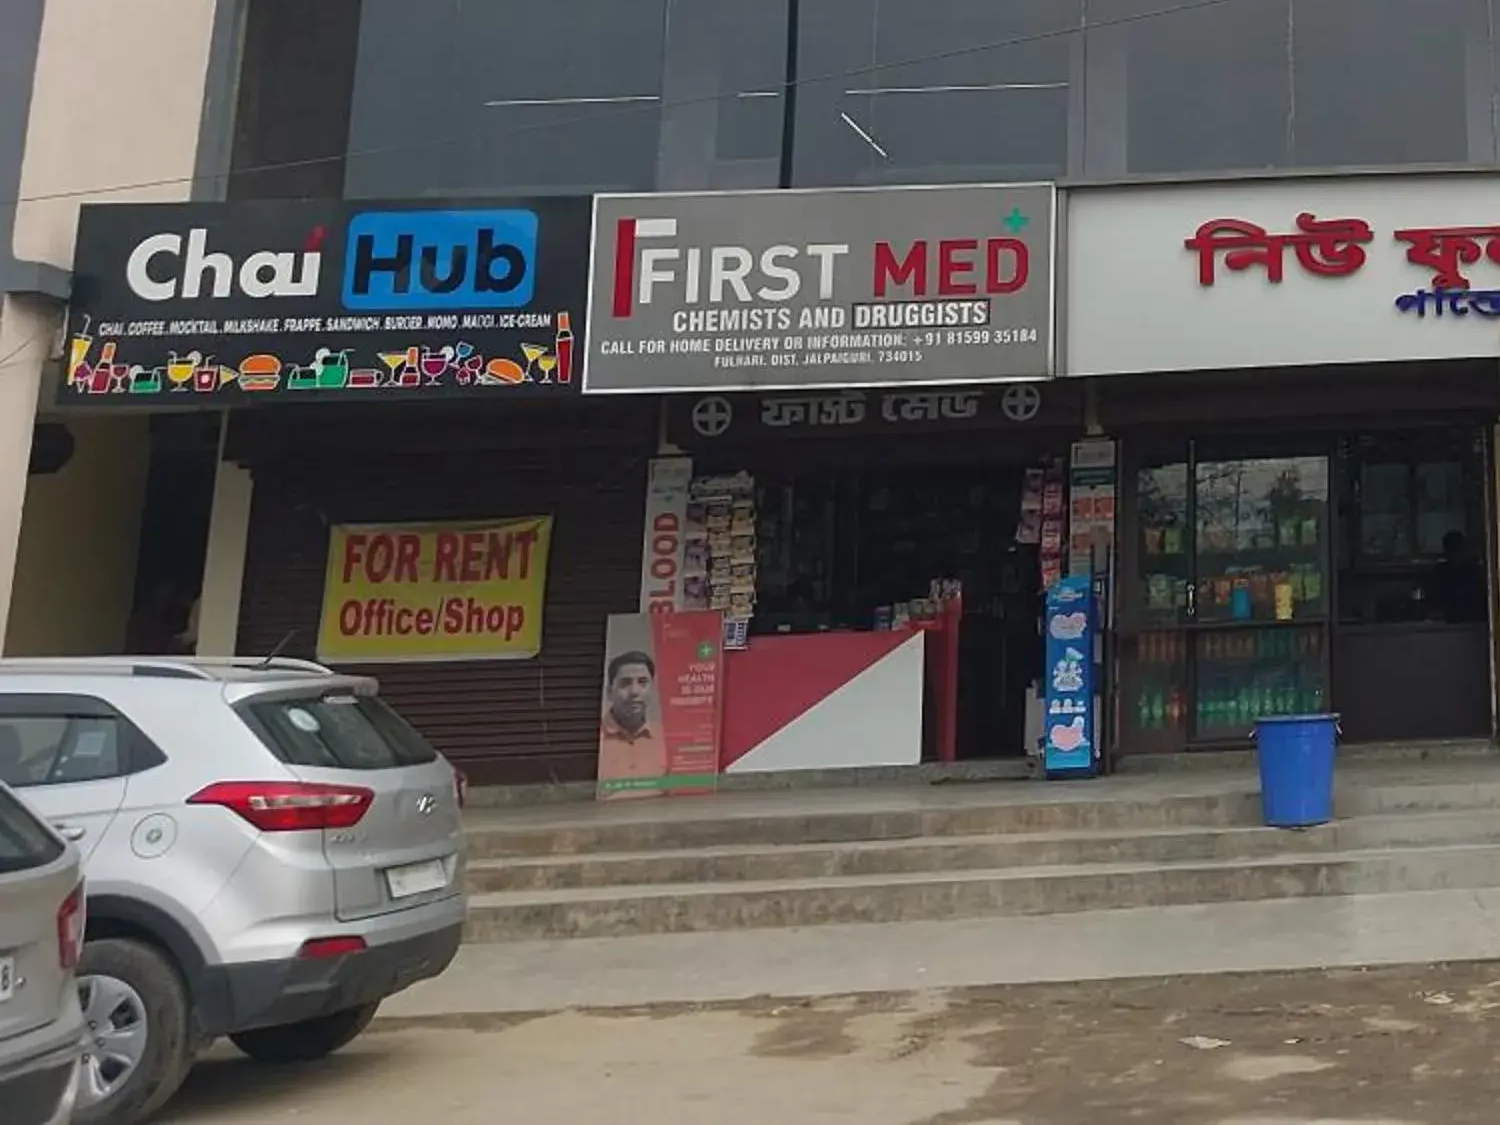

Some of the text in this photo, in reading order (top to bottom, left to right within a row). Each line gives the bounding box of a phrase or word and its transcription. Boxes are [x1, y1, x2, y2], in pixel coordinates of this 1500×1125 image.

[126, 224, 528, 301] Chai Hub
[613, 218, 1030, 317] FIRST MED
[1185, 212, 1374, 286] নিউ
[673, 301, 987, 332] CHEMISTS AND DRUGGISTS
[601, 340, 635, 355] CALL
[638, 339, 665, 354] FOR
[670, 338, 711, 353] HOME
[715, 337, 778, 352] DELIVERY
[783, 336, 803, 350] OR
[912, 332, 942, 346] +91
[947, 330, 990, 345] 81599
[993, 328, 1038, 343] 35184
[880, 391, 984, 421] মেড
[343, 529, 539, 583] FOR RENT
[339, 597, 525, 641] Office/Shop
